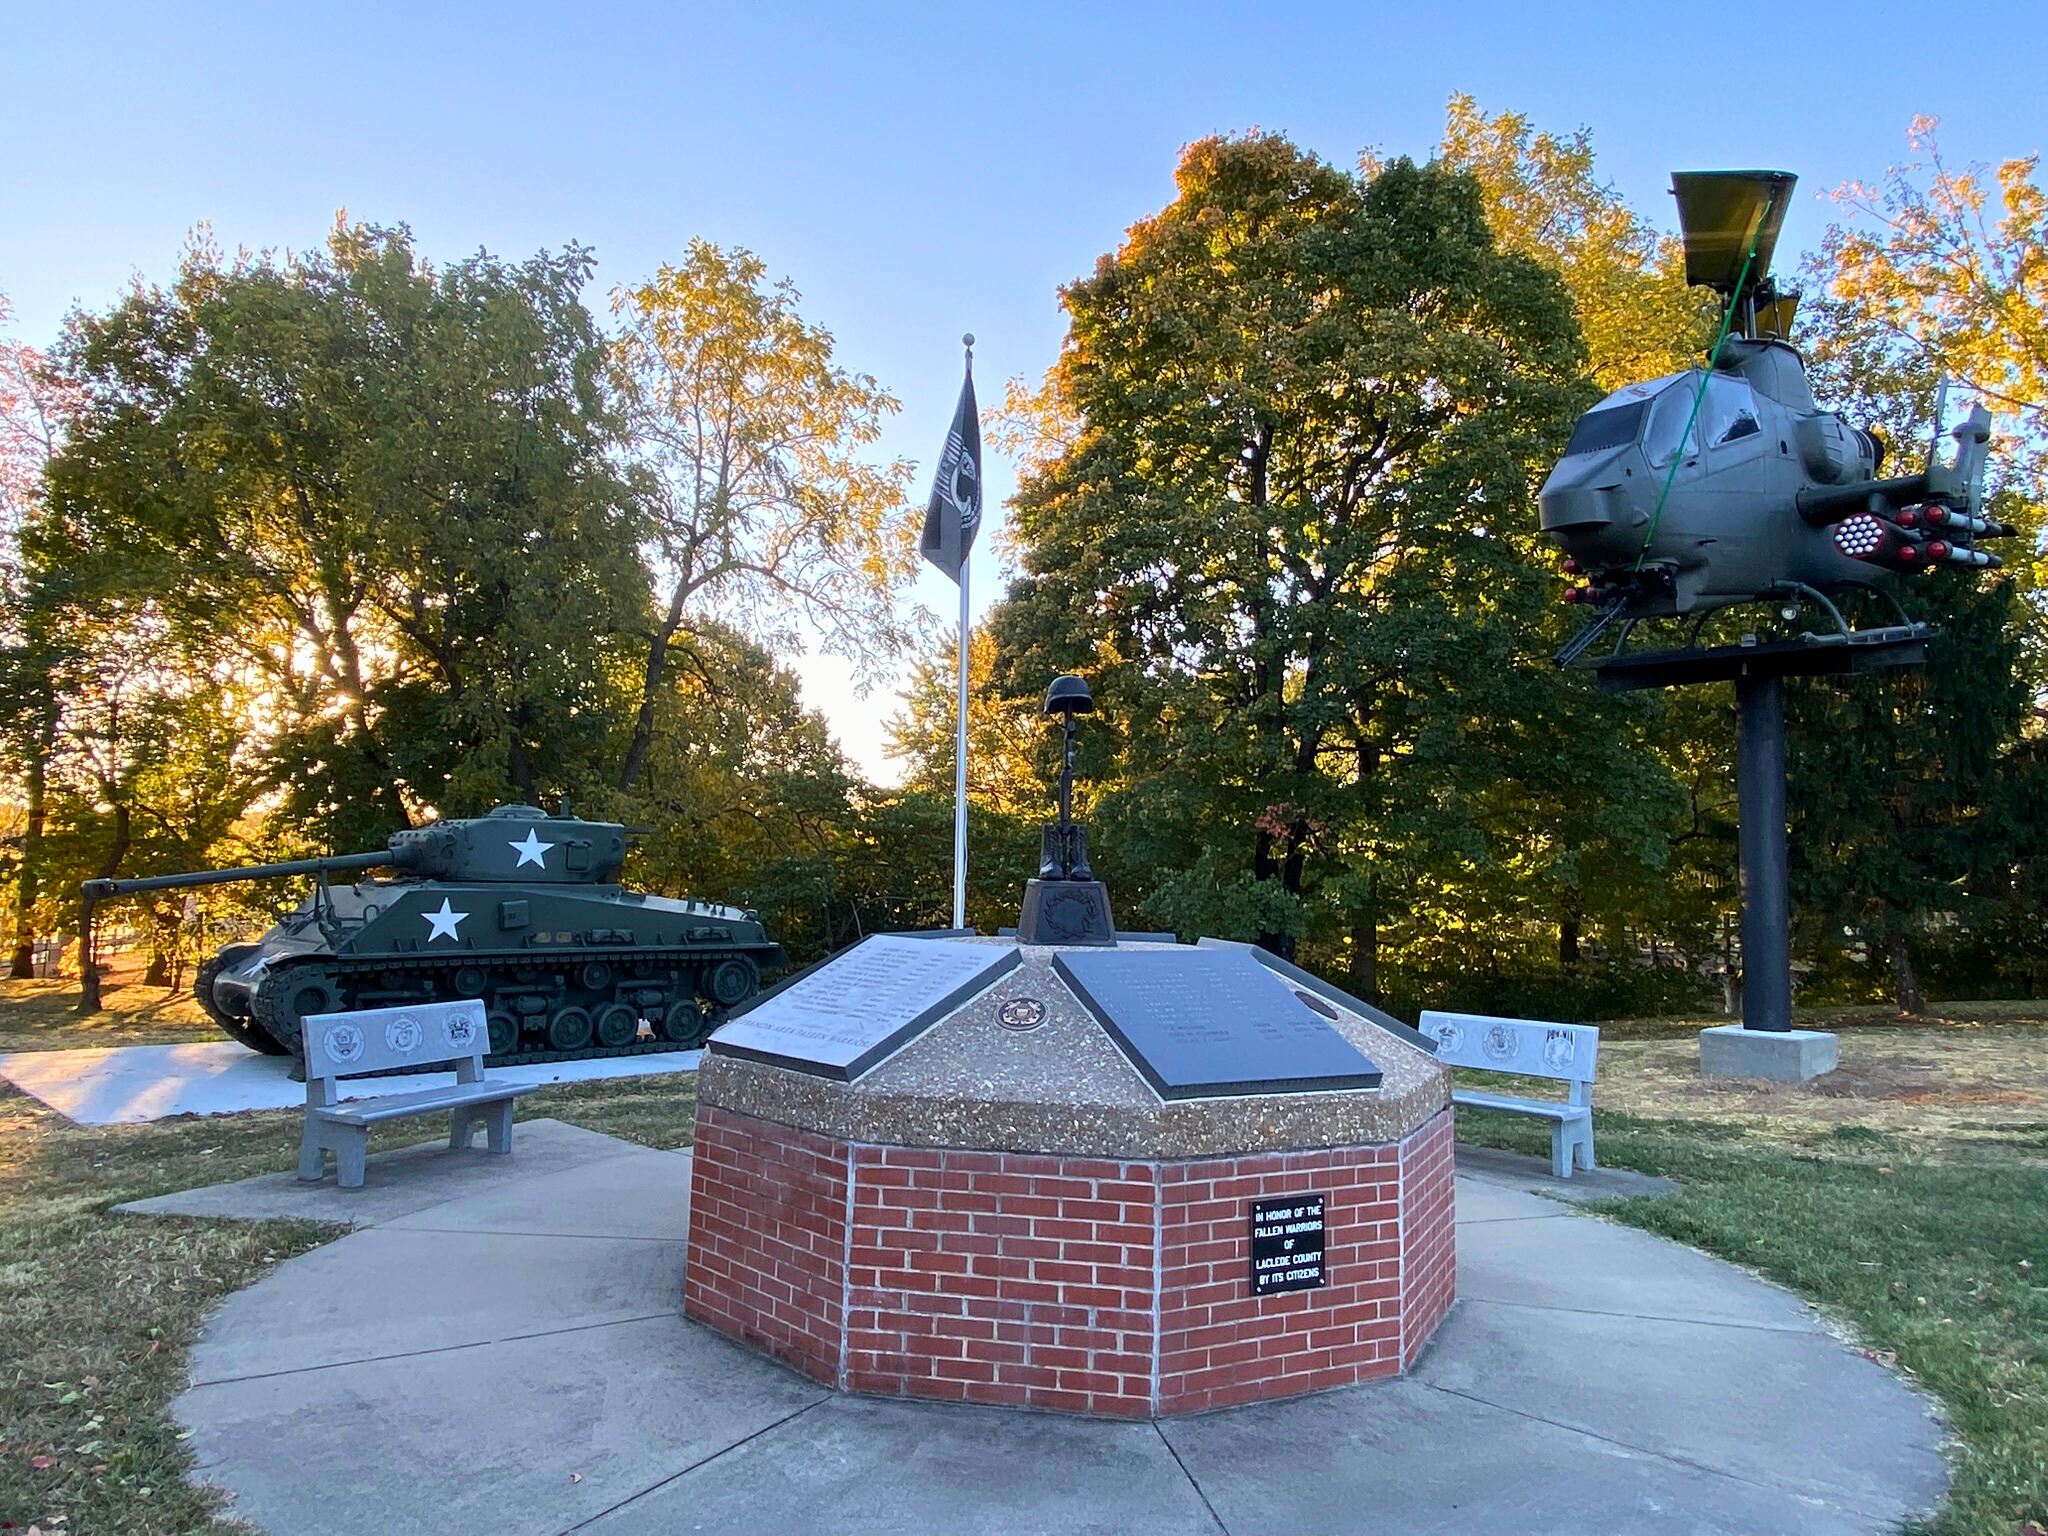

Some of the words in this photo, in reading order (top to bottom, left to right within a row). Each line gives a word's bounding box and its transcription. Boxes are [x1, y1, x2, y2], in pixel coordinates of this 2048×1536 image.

[1256, 1212, 1264, 1222] IN
[1266, 1209, 1292, 1222] HONOR
[1295, 1208, 1305, 1218] OF
[1307, 1206, 1322, 1216] THE
[1254, 1225, 1284, 1238] FALLEN
[1285, 1220, 1323, 1234] WARRIORS
[1284, 1239, 1295, 1250] OF
[1255, 1256, 1291, 1270] LACLEDE
[1292, 1251, 1322, 1265] COUNTY
[1260, 1275, 1270, 1286] BY
[1272, 1273, 1284, 1283] ITS
[1286, 1267, 1320, 1281] CITIZENS
